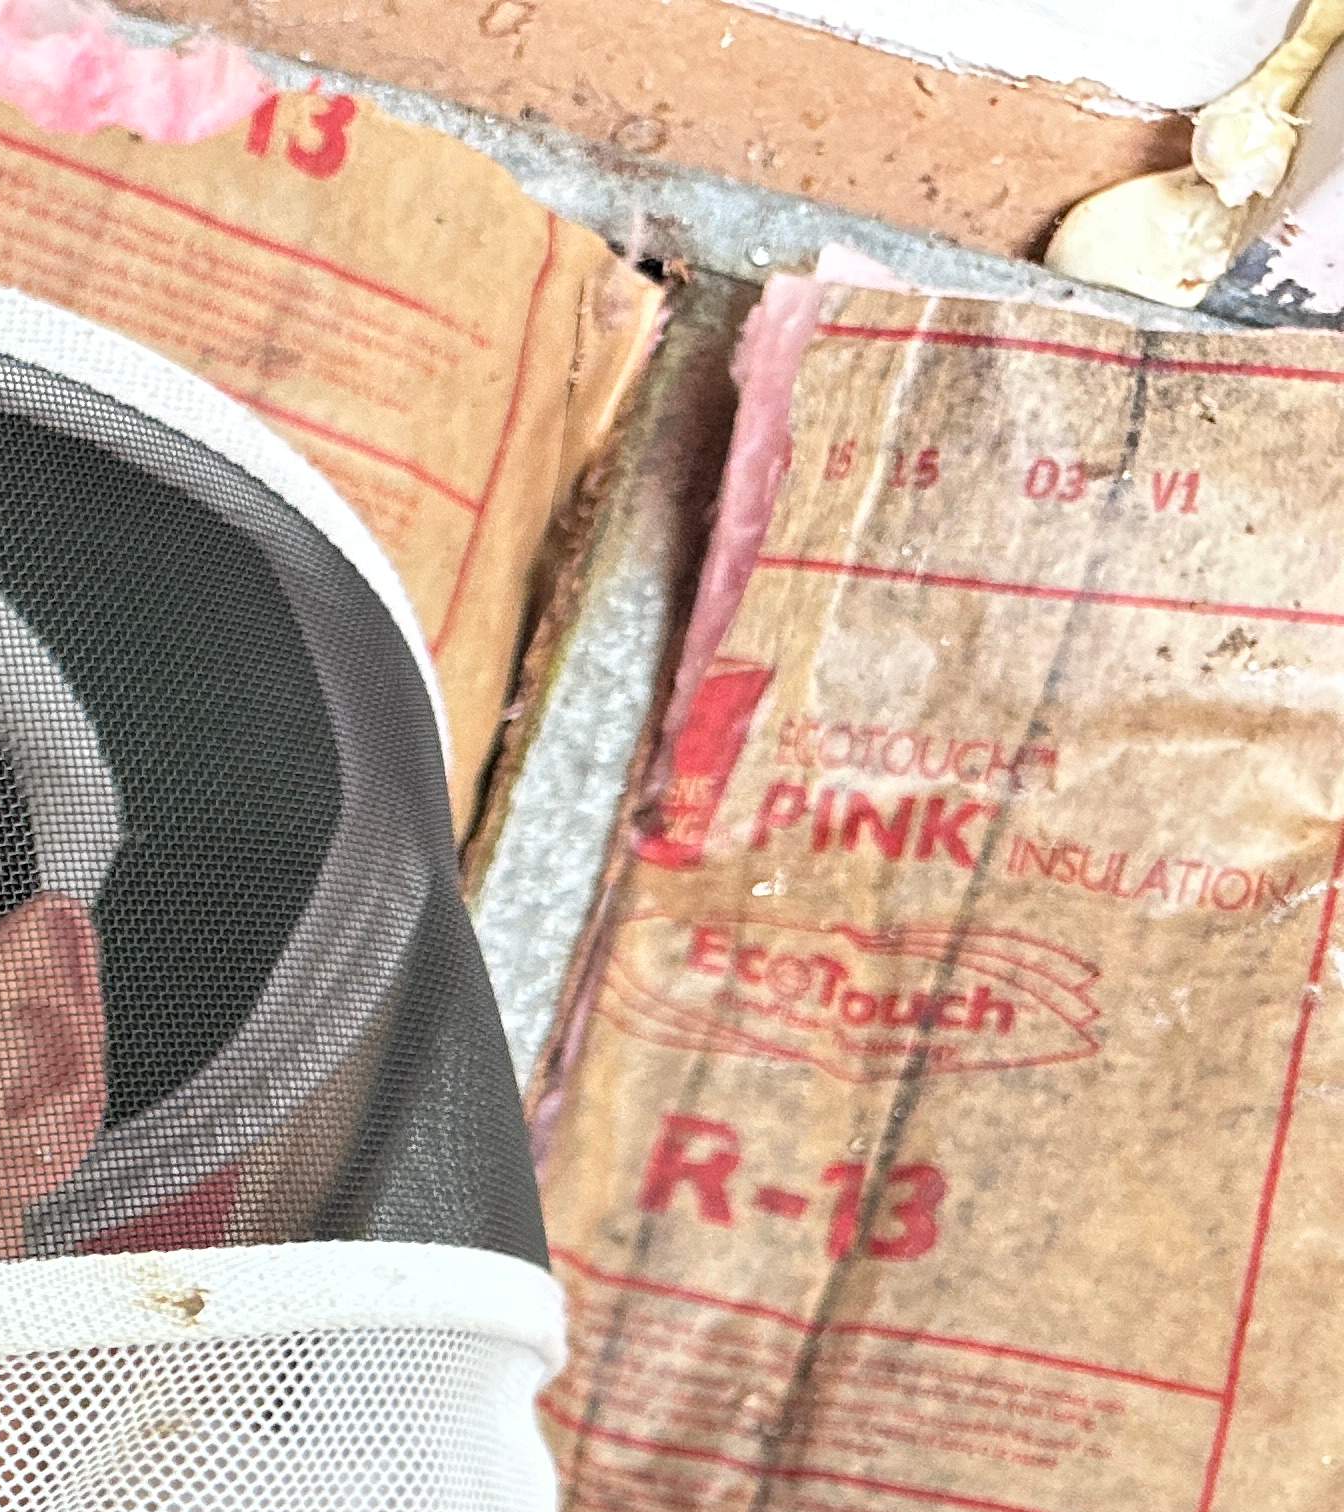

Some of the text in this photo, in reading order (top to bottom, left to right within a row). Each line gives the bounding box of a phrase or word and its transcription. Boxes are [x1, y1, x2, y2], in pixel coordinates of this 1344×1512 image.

[887, 446, 940, 490] 15
[1152, 468, 1200, 513] V1
[750, 779, 1000, 871] PINK
[1007, 833, 1297, 912] INSULATION
[637, 1113, 949, 1262] R-13
